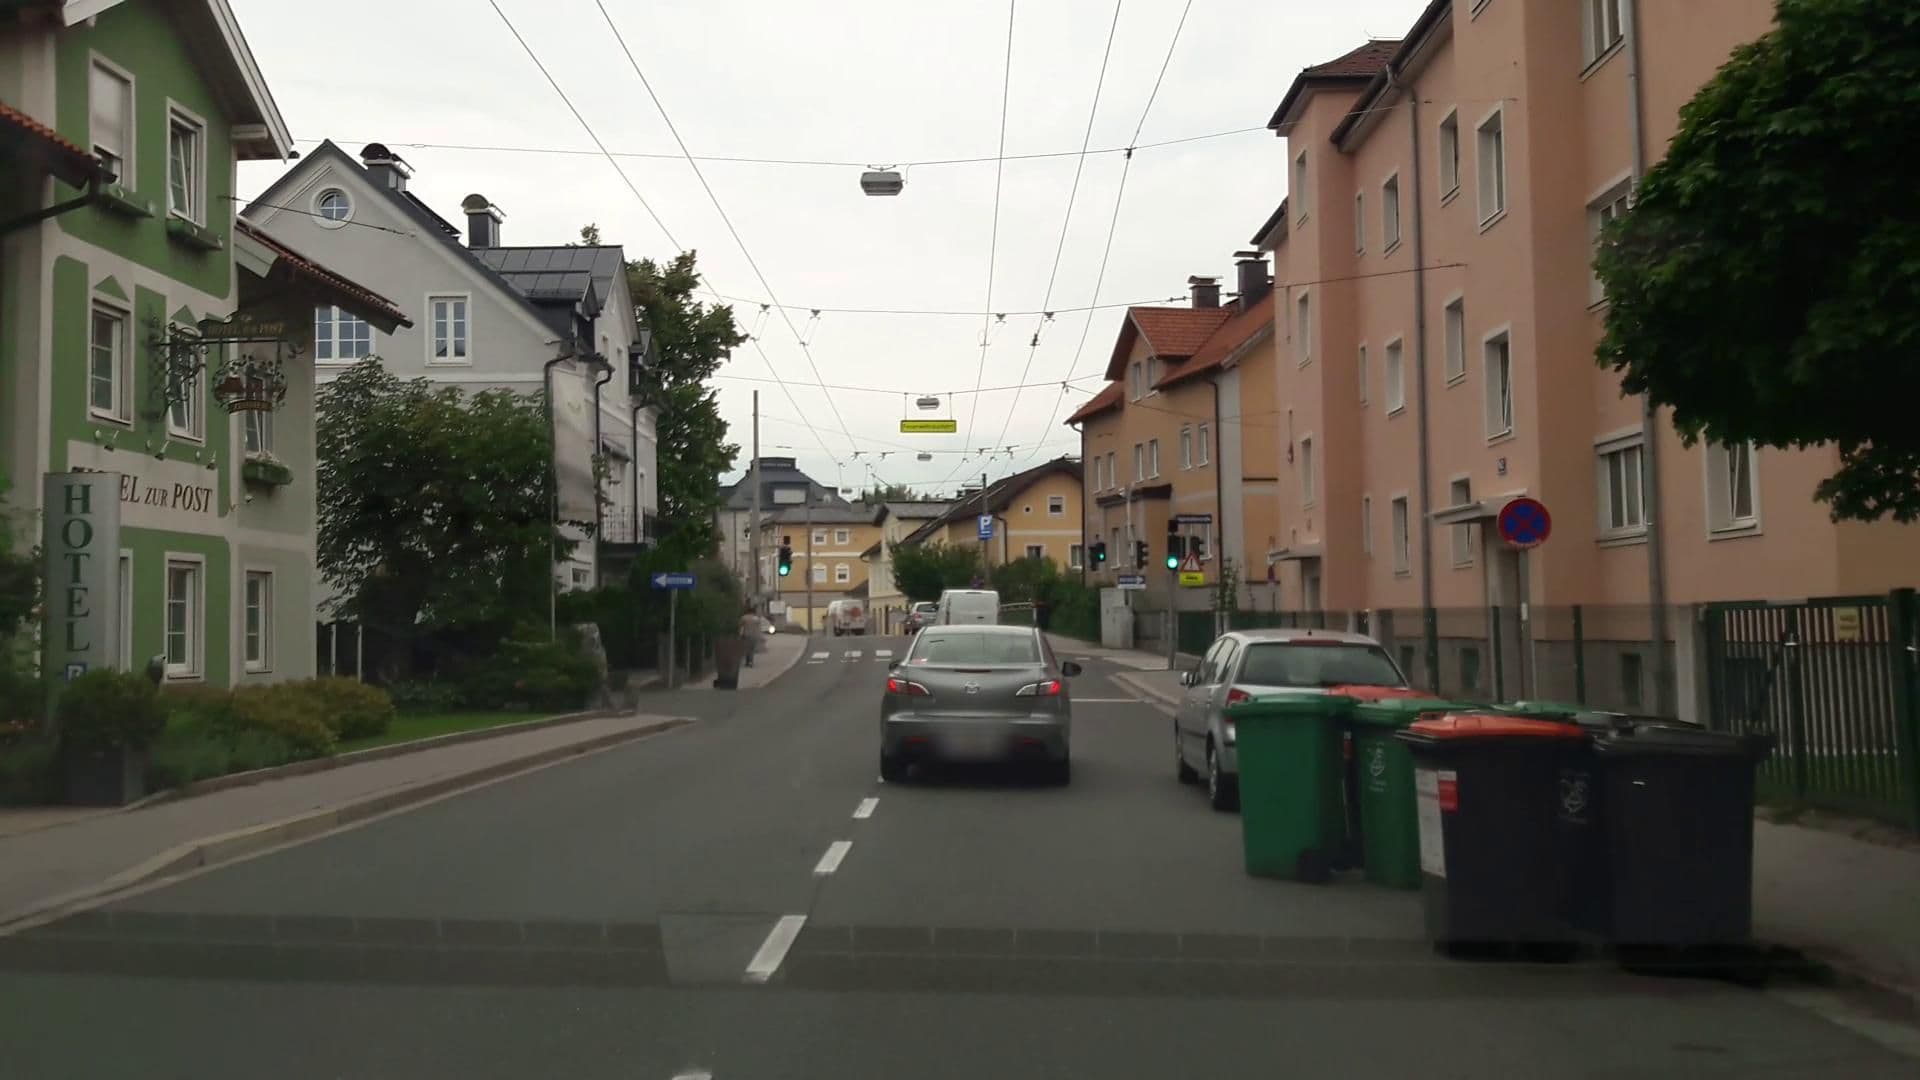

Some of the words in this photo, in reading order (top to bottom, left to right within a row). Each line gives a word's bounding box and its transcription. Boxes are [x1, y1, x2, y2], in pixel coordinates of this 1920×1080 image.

[144, 486, 169, 507] ZUR
[171, 482, 213, 512] POST
[61, 484, 94, 652] HOTEL
